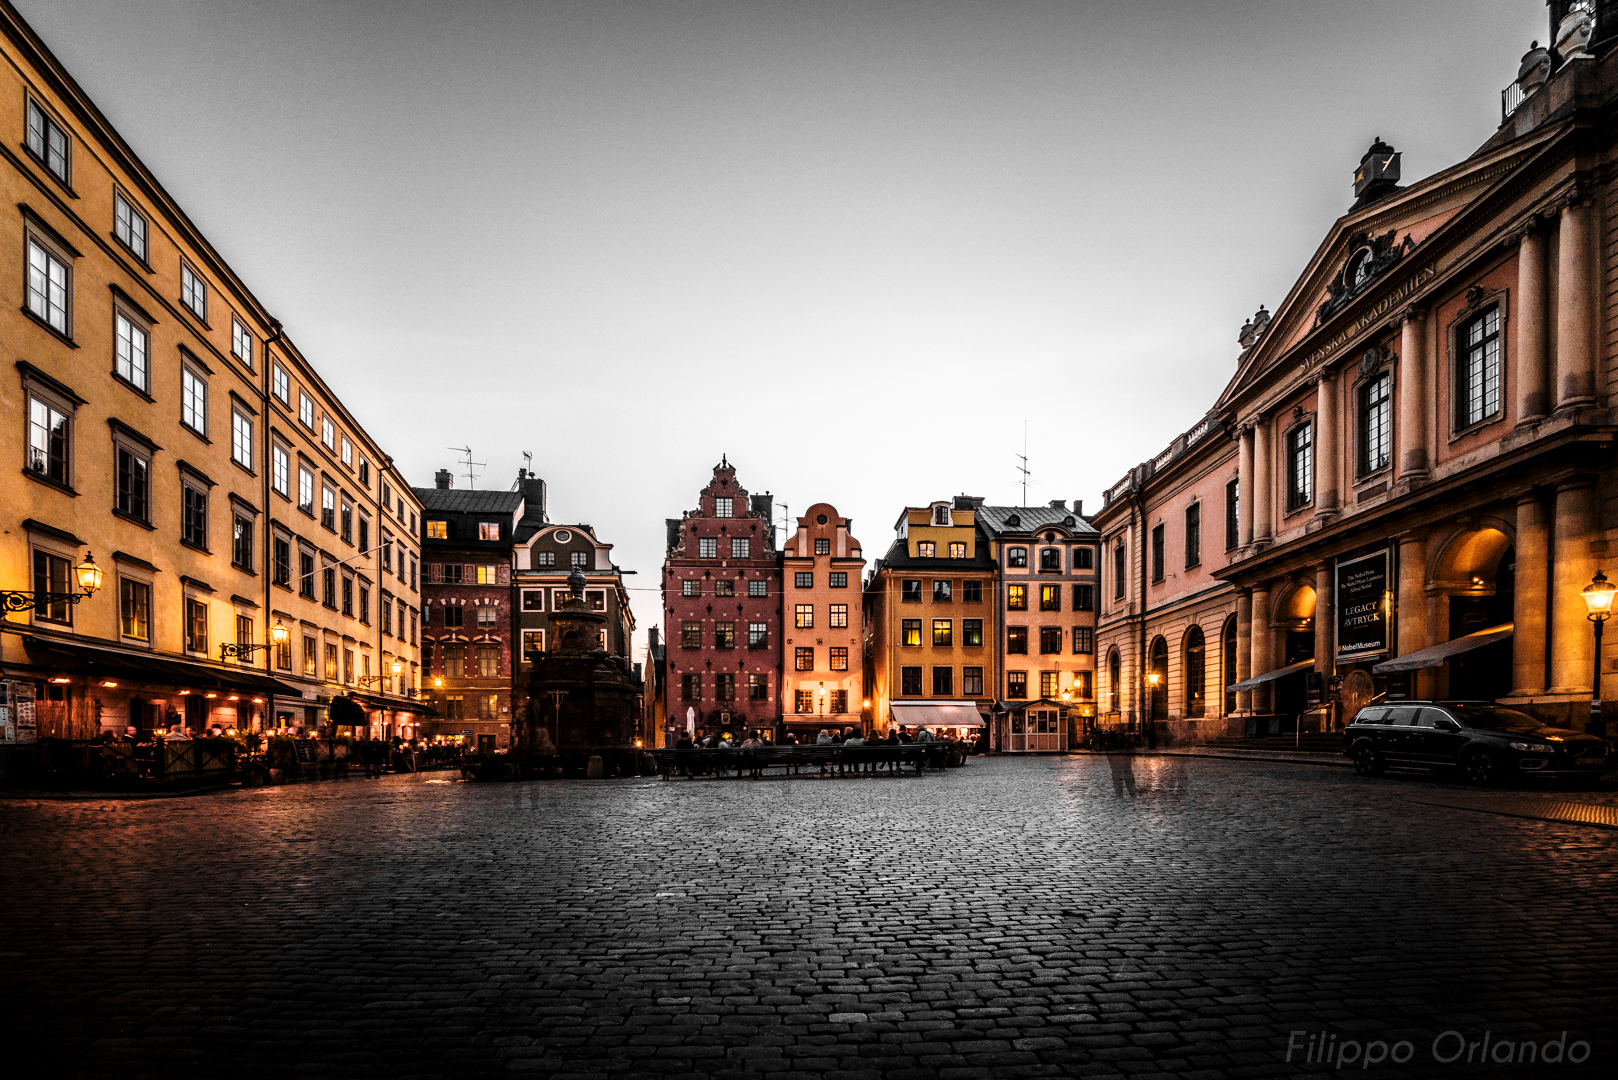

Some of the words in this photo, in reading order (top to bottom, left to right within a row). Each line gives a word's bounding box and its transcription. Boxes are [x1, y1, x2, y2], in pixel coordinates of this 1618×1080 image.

[1300, 331, 1347, 370] SVENSKA
[1355, 262, 1435, 331] AKADEMIEN
[1345, 601, 1378, 616] LEGACY
[1343, 612, 1380, 628] AVTRYCK
